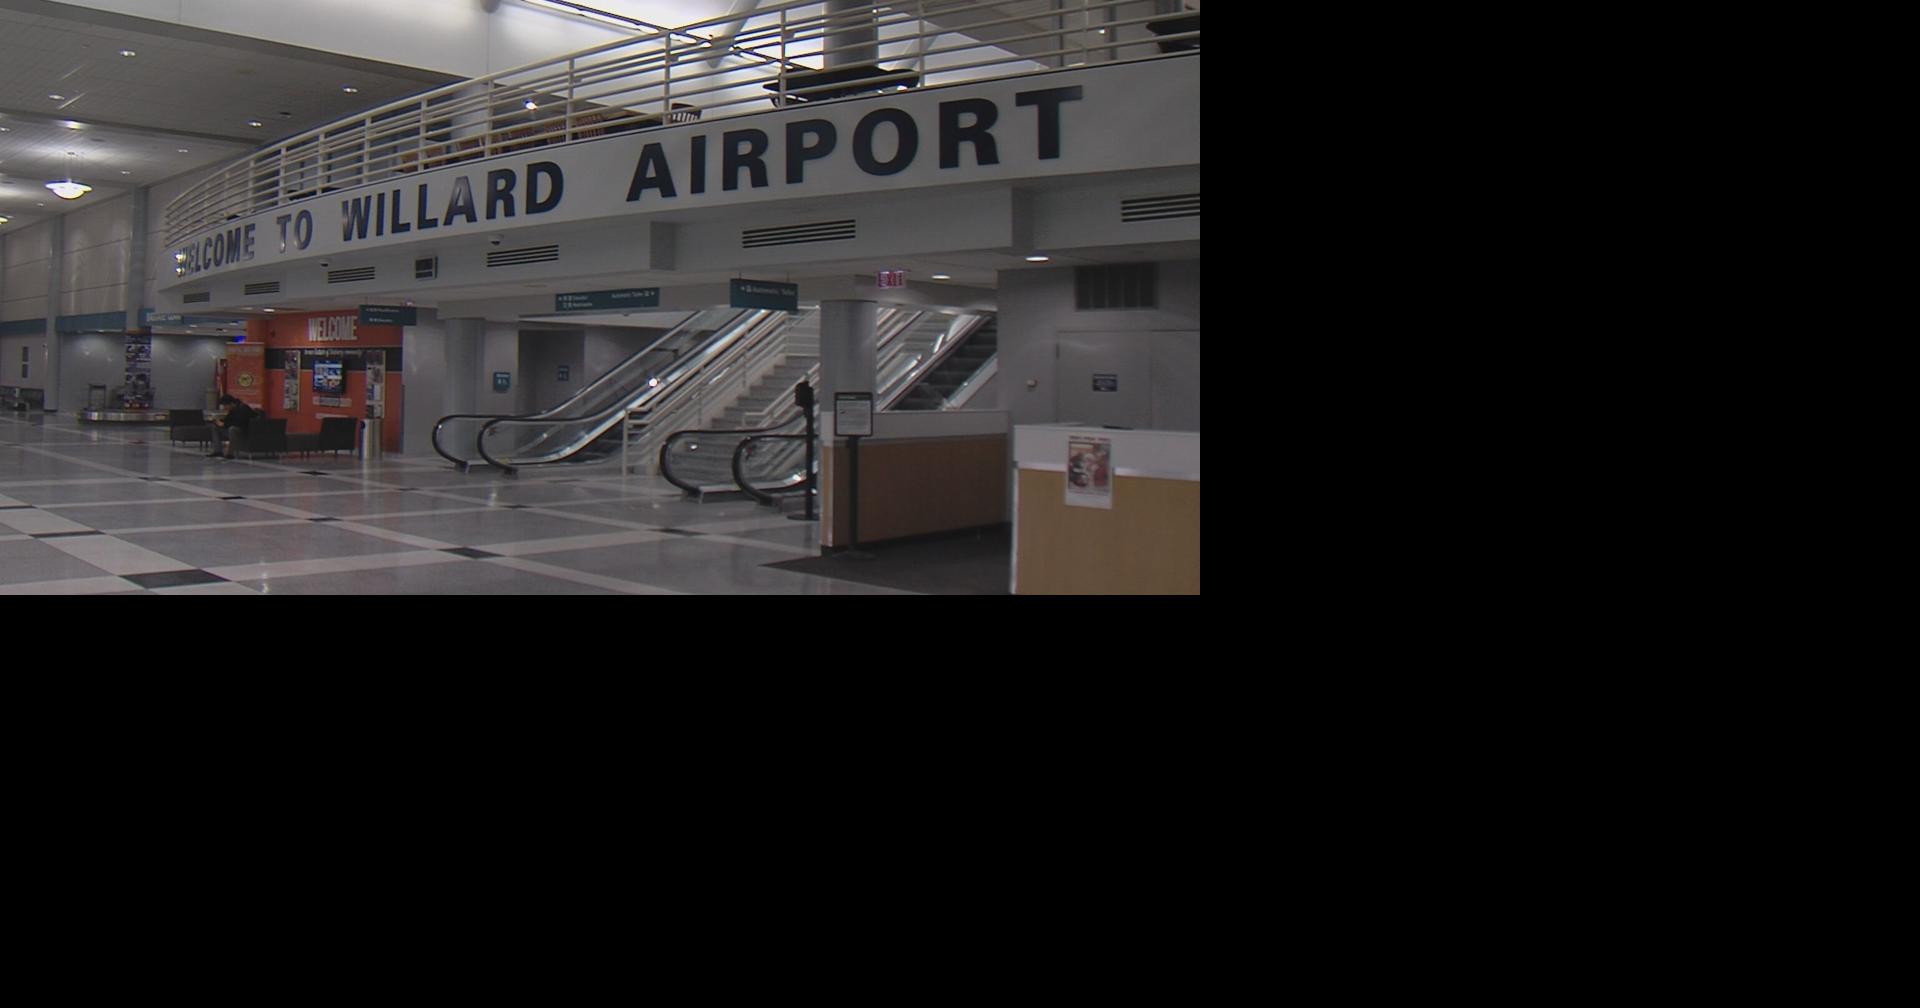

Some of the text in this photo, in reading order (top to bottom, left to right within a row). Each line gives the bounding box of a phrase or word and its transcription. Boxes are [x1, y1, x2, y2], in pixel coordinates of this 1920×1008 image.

[277, 209, 313, 254] TO
[342, 161, 564, 241] WILLARD
[626, 85, 1083, 202] AIRPORT
[879, 271, 904, 288] EXIT
[308, 315, 358, 342] WELCOME
